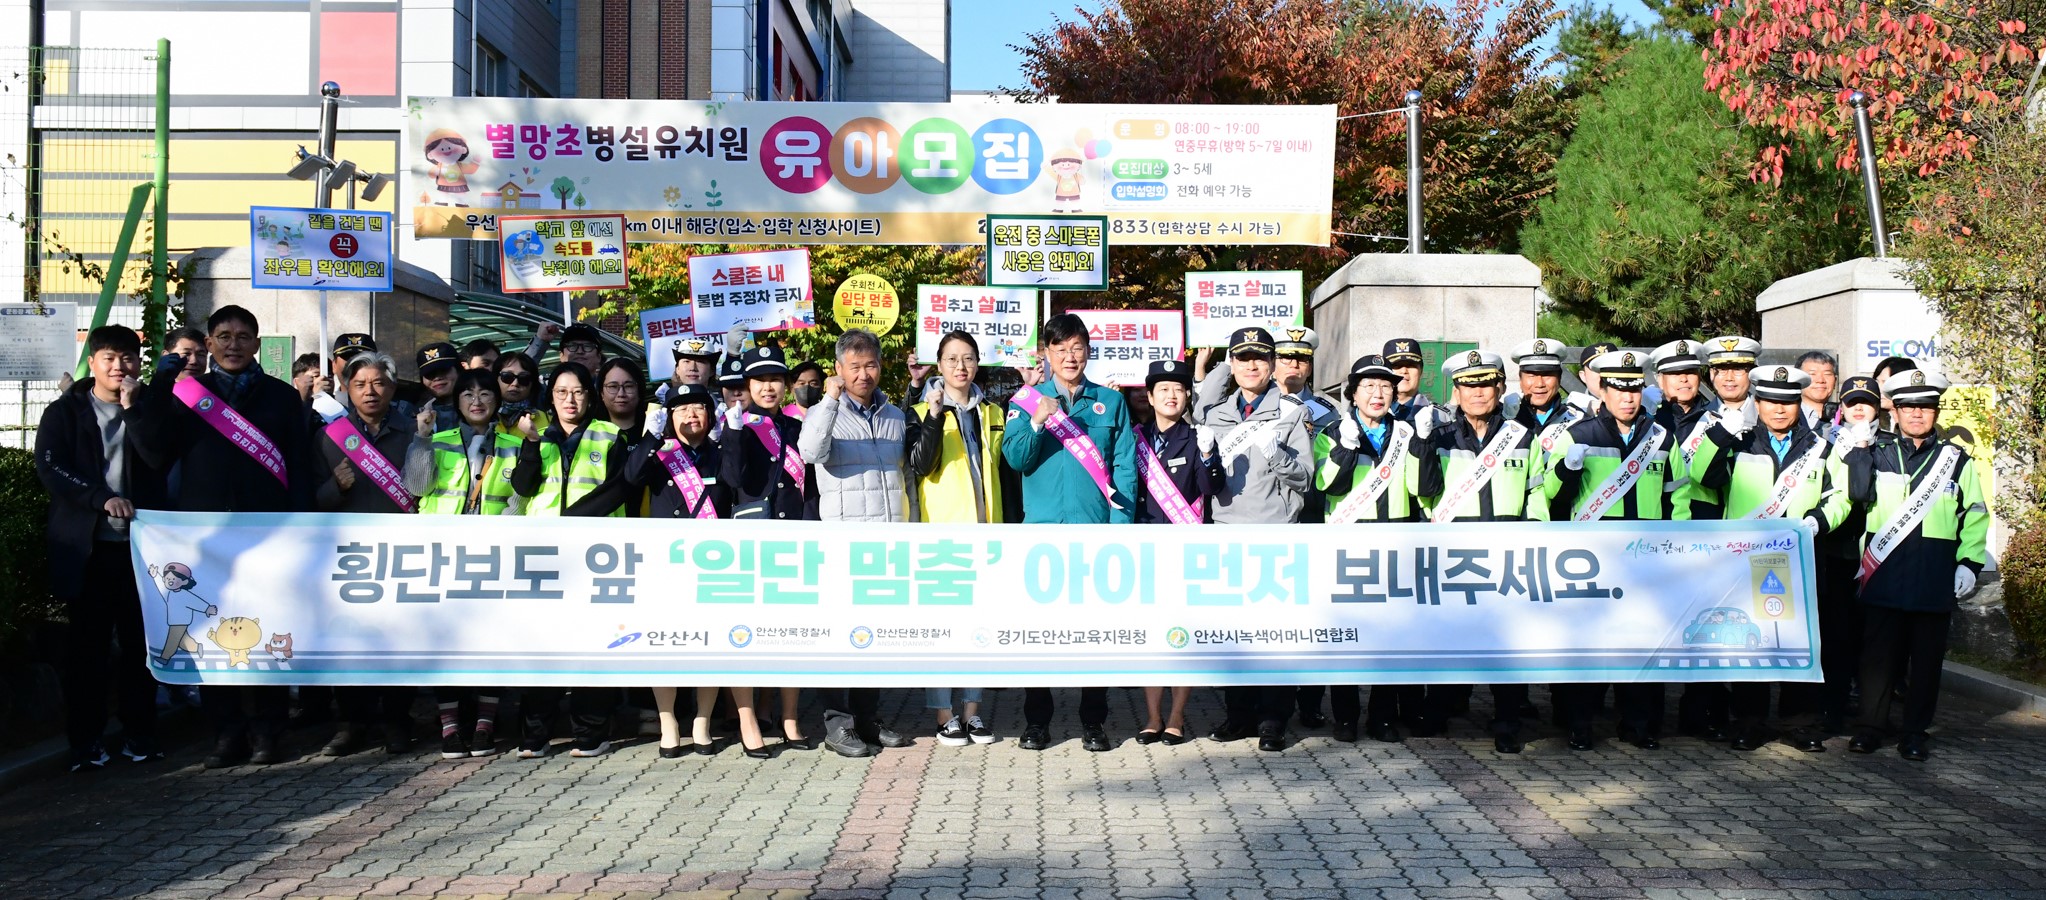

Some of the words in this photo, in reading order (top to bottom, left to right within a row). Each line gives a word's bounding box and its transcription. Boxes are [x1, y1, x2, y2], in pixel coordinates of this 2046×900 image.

[1175, 122, 1210, 135] 08:00
[1226, 122, 1260, 135] 19:00
[773, 130, 1030, 180] 유아모집
[1174, 139, 1246, 154] 연중무휴(방학
[1249, 139, 1282, 154] 5~7일
[1286, 139, 1313, 154] 이내)
[1118, 162, 1165, 176] 모집대상
[1116, 185, 1166, 198] 입학설명회
[1176, 185, 1199, 198] 전화
[1203, 185, 1226, 198] 예약
[1229, 185, 1253, 198] 가능
[308, 214, 335, 230] 길을
[339, 216, 365, 231] 건널
[369, 217, 383, 232] 땐
[535, 221, 565, 239] 학교
[570, 220, 585, 238] 앞
[588, 222, 614, 237] 에선
[651, 217, 682, 234] 이내
[797, 217, 881, 238] 신청사이트)
[1217, 221, 1243, 235] 수시
[1248, 221, 1282, 236] 가능)
[994, 225, 1022, 246] 운전
[1026, 226, 1040, 246] 중
[1044, 225, 1100, 246] 스마트폰
[337, 237, 352, 254] 꼭
[554, 241, 594, 257] 속도를
[264, 258, 313, 276] 좌우를
[317, 259, 385, 278] 확인해요!
[542, 260, 585, 277] 낮춰야
[589, 259, 622, 275] 해요!
[1002, 251, 1044, 272] 사용은
[1048, 251, 1095, 272] 안돼요!
[711, 265, 763, 287] 스쿨존
[768, 263, 786, 284] 내
[850, 279, 876, 291] 우회전
[877, 280, 886, 291] 시
[1198, 280, 1240, 298] 멈추고
[1244, 279, 1287, 297] 살피고
[697, 292, 725, 309] 불법
[729, 290, 771, 306] 주정차
[774, 287, 802, 303] 금지
[841, 291, 867, 306] 일단
[869, 293, 894, 308] 멈춤
[930, 294, 974, 313] 멈추고
[977, 296, 1021, 314] 살피고
[1192, 301, 1248, 320] 확인하고
[1251, 304, 1294, 318] 건너요!
[923, 316, 980, 336] 확인하고
[984, 322, 1027, 337] 건너요!
[1089, 324, 1138, 341] 스쿨존
[1143, 324, 1159, 342] 내
[1104, 346, 1144, 360] 주정차
[1148, 347, 1174, 361] 금지
[1867, 339, 1936, 357] SECOM
[1765, 538, 1796, 551] 안산
[331, 541, 564, 604] 횡단보도
[585, 542, 643, 604] 앞
[1023, 542, 1155, 606] 아이
[1183, 542, 1310, 606] 먼저
[1331, 547, 1624, 606] 보내주세요.
[1767, 601, 1781, 612] 30
[647, 630, 709, 647] 안산시
[756, 626, 831, 638] 안산상록경찰서
[876, 627, 951, 639] 안산단원경찰서
[997, 629, 1147, 645] 경기도안산교육지원청
[1194, 627, 1359, 644] 안산시녹색어머니연합회
